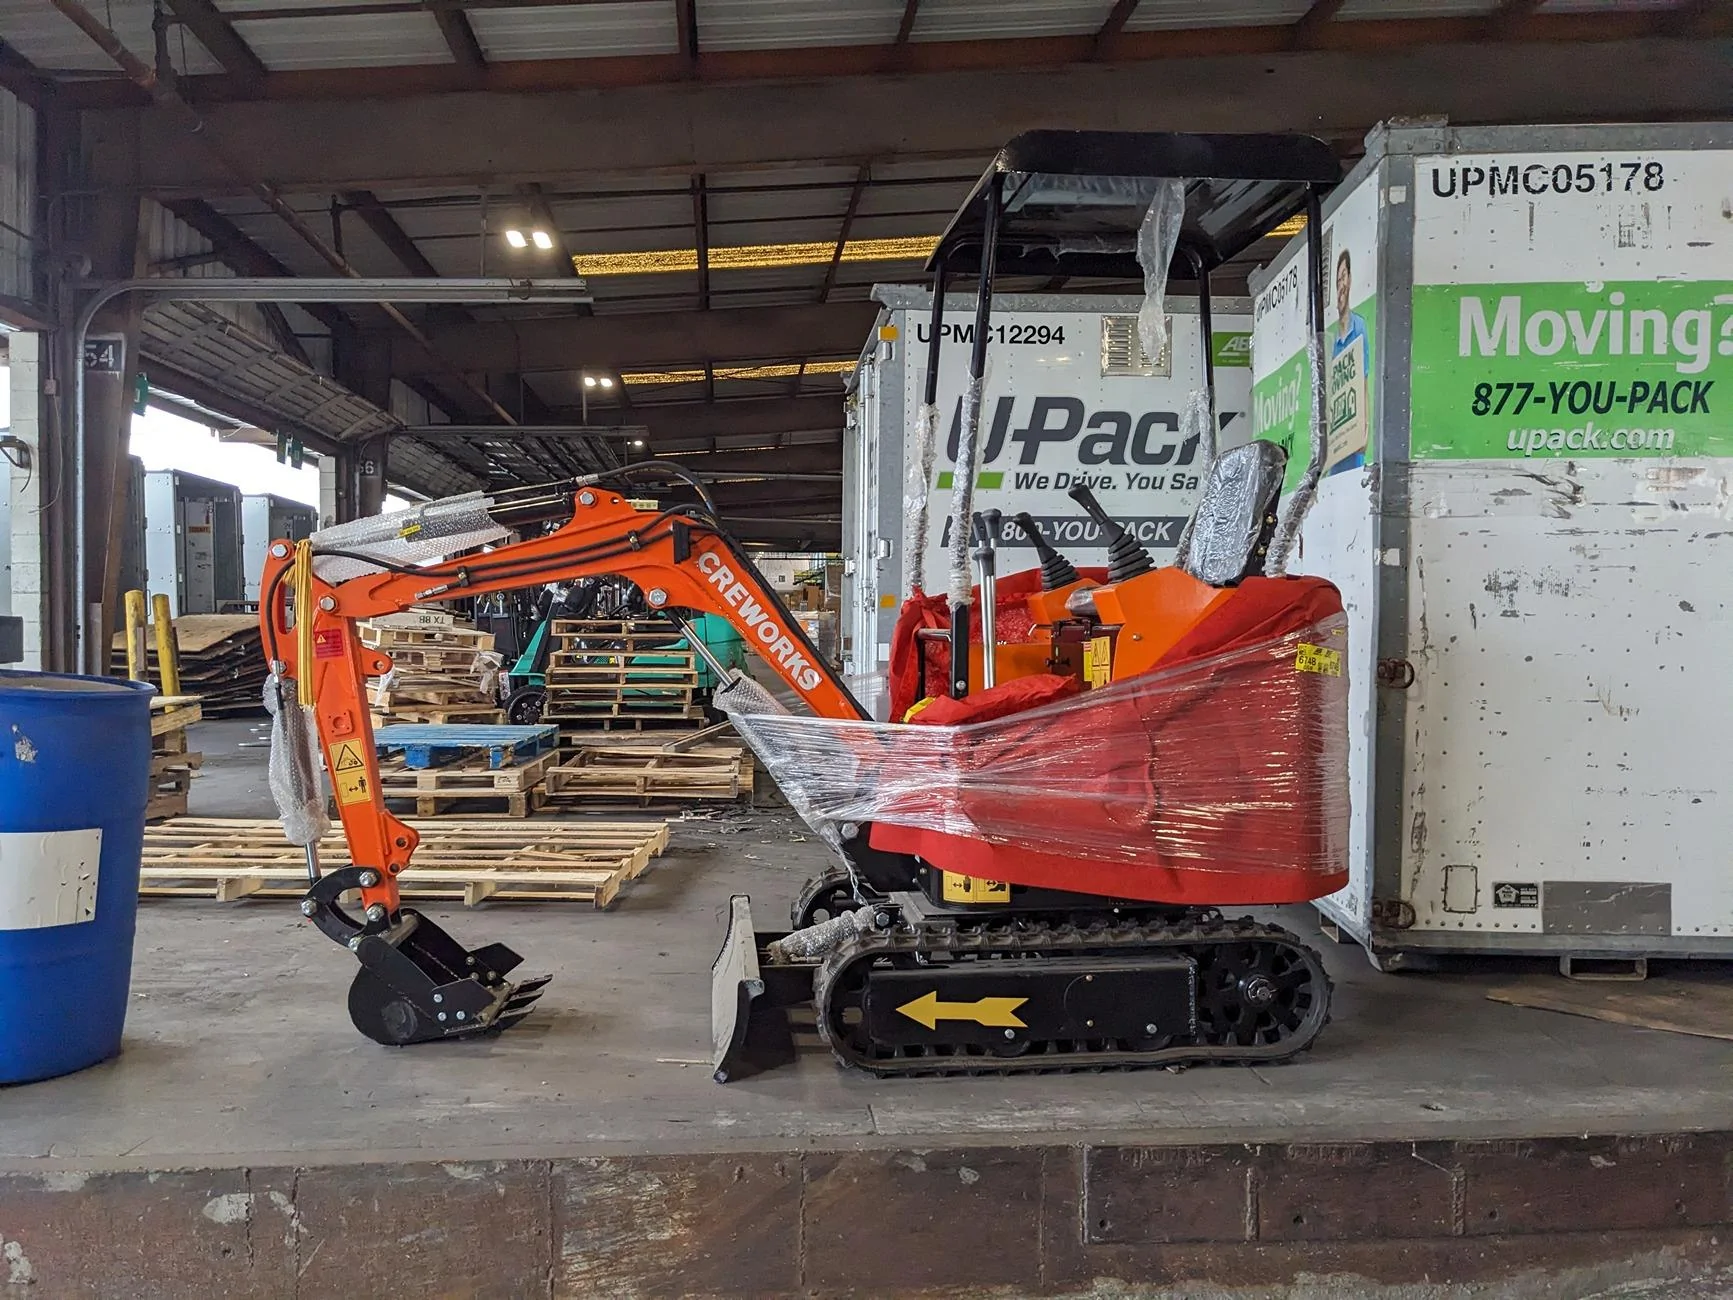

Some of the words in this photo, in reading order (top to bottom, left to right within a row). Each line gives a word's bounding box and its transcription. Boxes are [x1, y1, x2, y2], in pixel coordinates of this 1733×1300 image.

[1432, 162, 1665, 198] UPMC05178
[1458, 291, 1733, 374] Moving?
[1471, 379, 1716, 416] 877-YOU-PACK
[1507, 421, 1676, 457] upack.com
[1014, 472, 1049, 490] We
[1053, 471, 1117, 490] Drive.
[1125, 472, 1164, 490] You
[1170, 472, 1199, 490] Sa
[698, 551, 823, 691] CREWORKS
